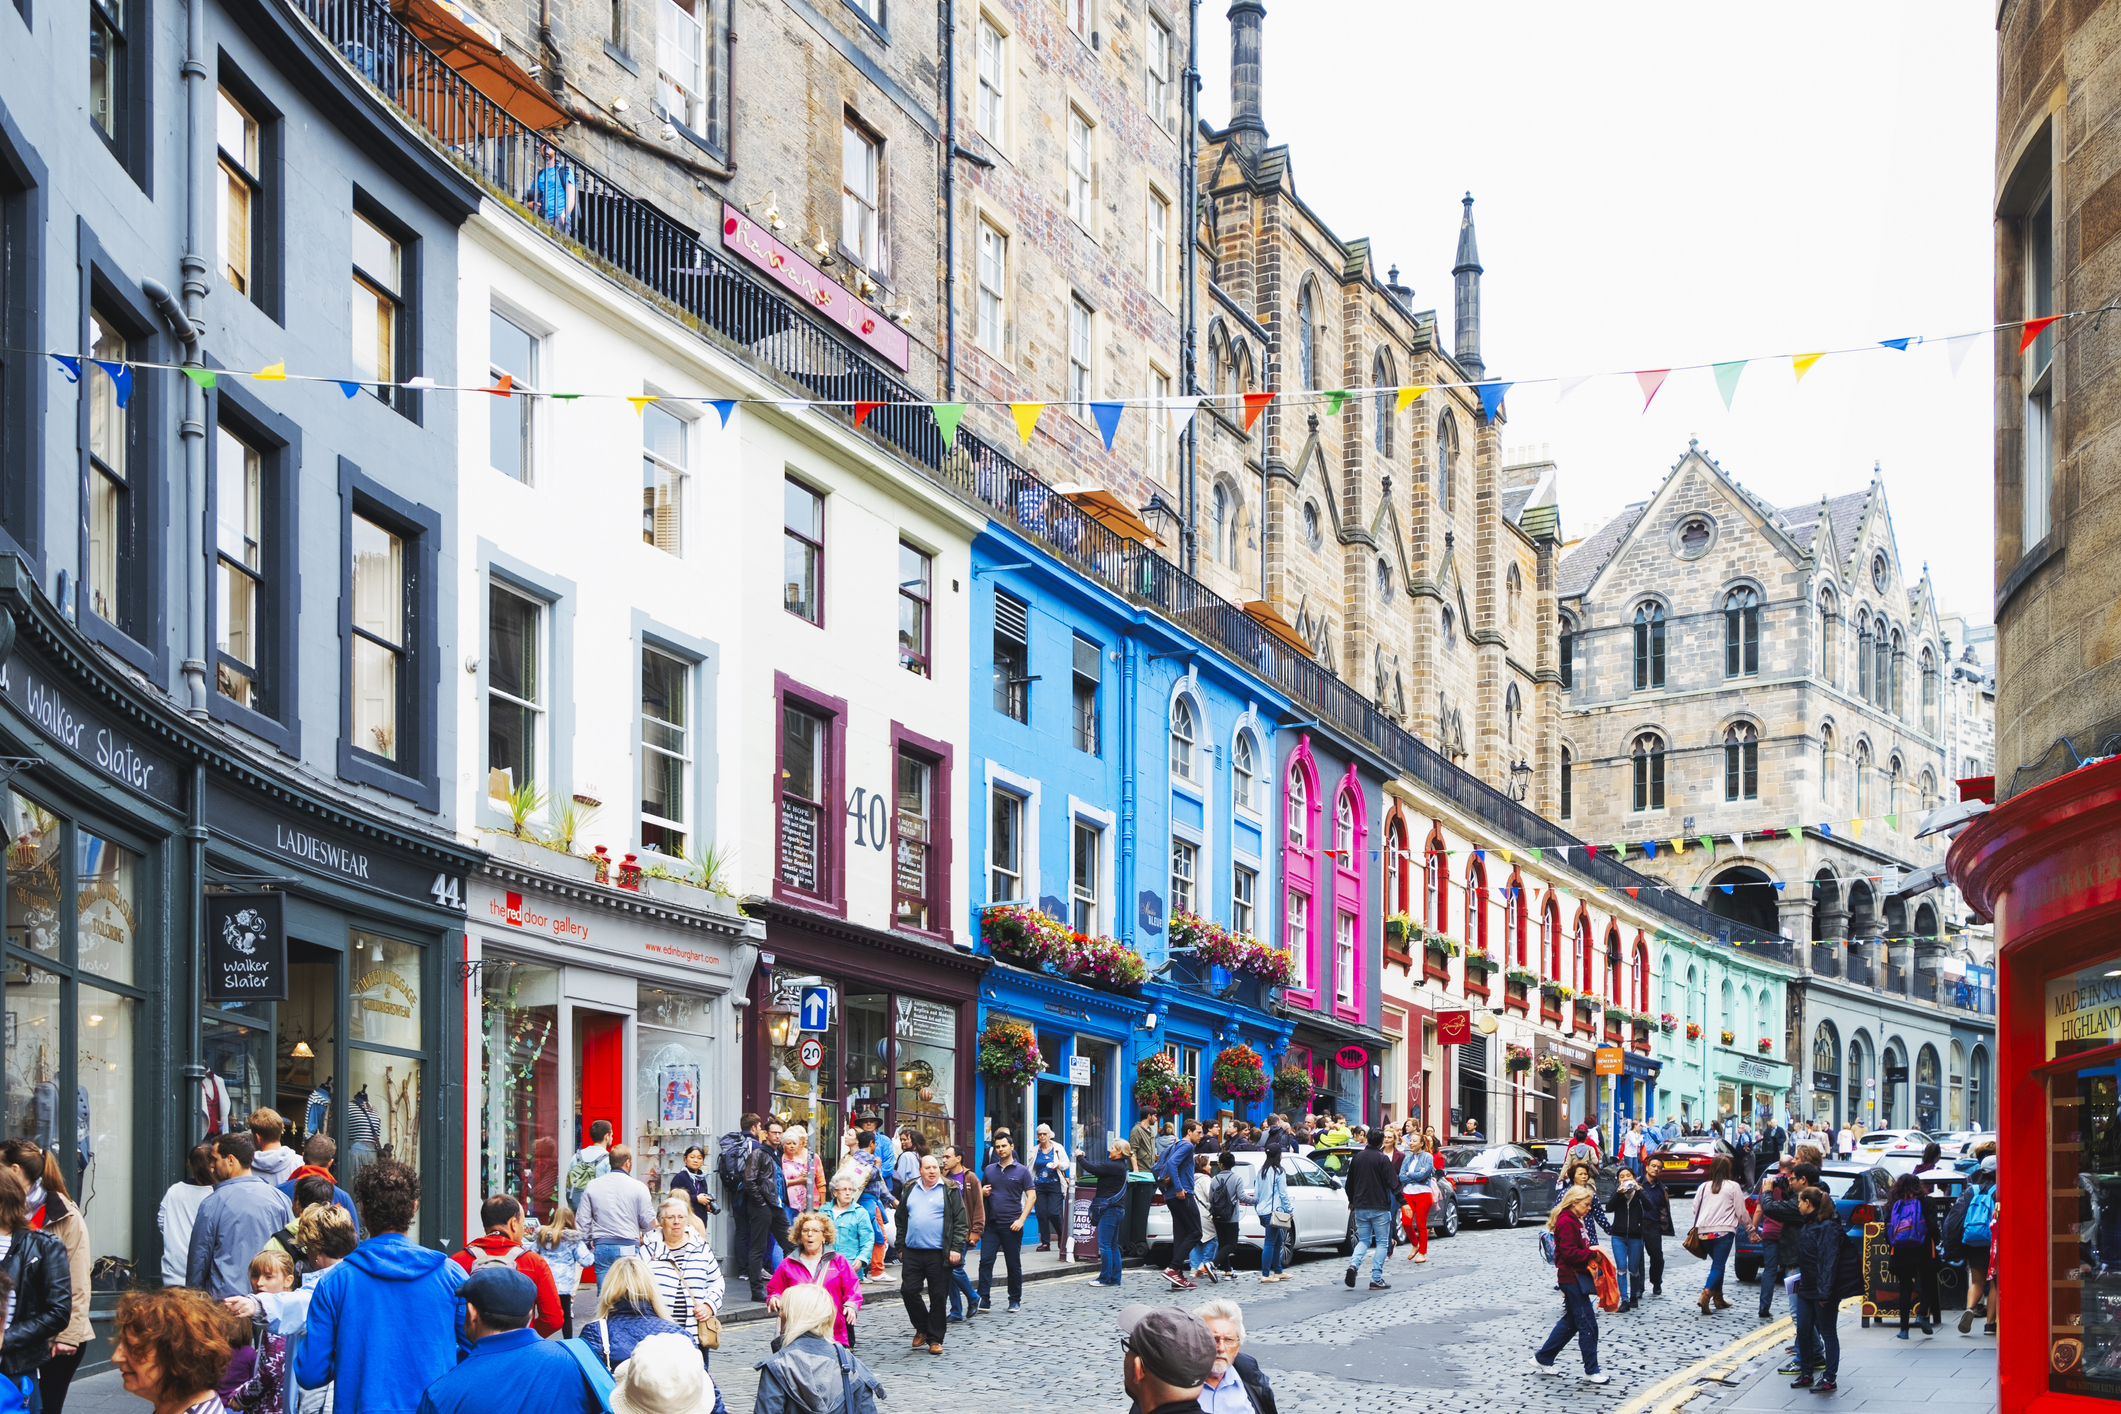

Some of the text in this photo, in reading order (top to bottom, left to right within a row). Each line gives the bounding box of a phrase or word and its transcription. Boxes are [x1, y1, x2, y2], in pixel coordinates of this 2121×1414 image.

[28, 676, 84, 749] Walker
[97, 728, 153, 790] Slater
[847, 787, 887, 852] 40
[902, 818, 921, 831] NOT BE
[277, 824, 369, 879] LADIESWEAR
[105, 906, 111, 920] &
[490, 898, 589, 940] the red door gallery
[93, 918, 124, 944] TAILORING
[645, 942, 720, 965] www.edinburghart.com
[354, 969, 383, 997] TWEED
[2055, 987, 2087, 1017] MADE
[2088, 982, 2101, 1007] IN
[804, 1047, 820, 1060] 20
[1549, 1042, 1587, 1061] THE WHISKY SHOP
[2066, 1379, 2078, 1389] REAL
[2078, 1381, 2101, 1392] SCOTTISH
[2101, 1383, 2115, 1394] KILTS
